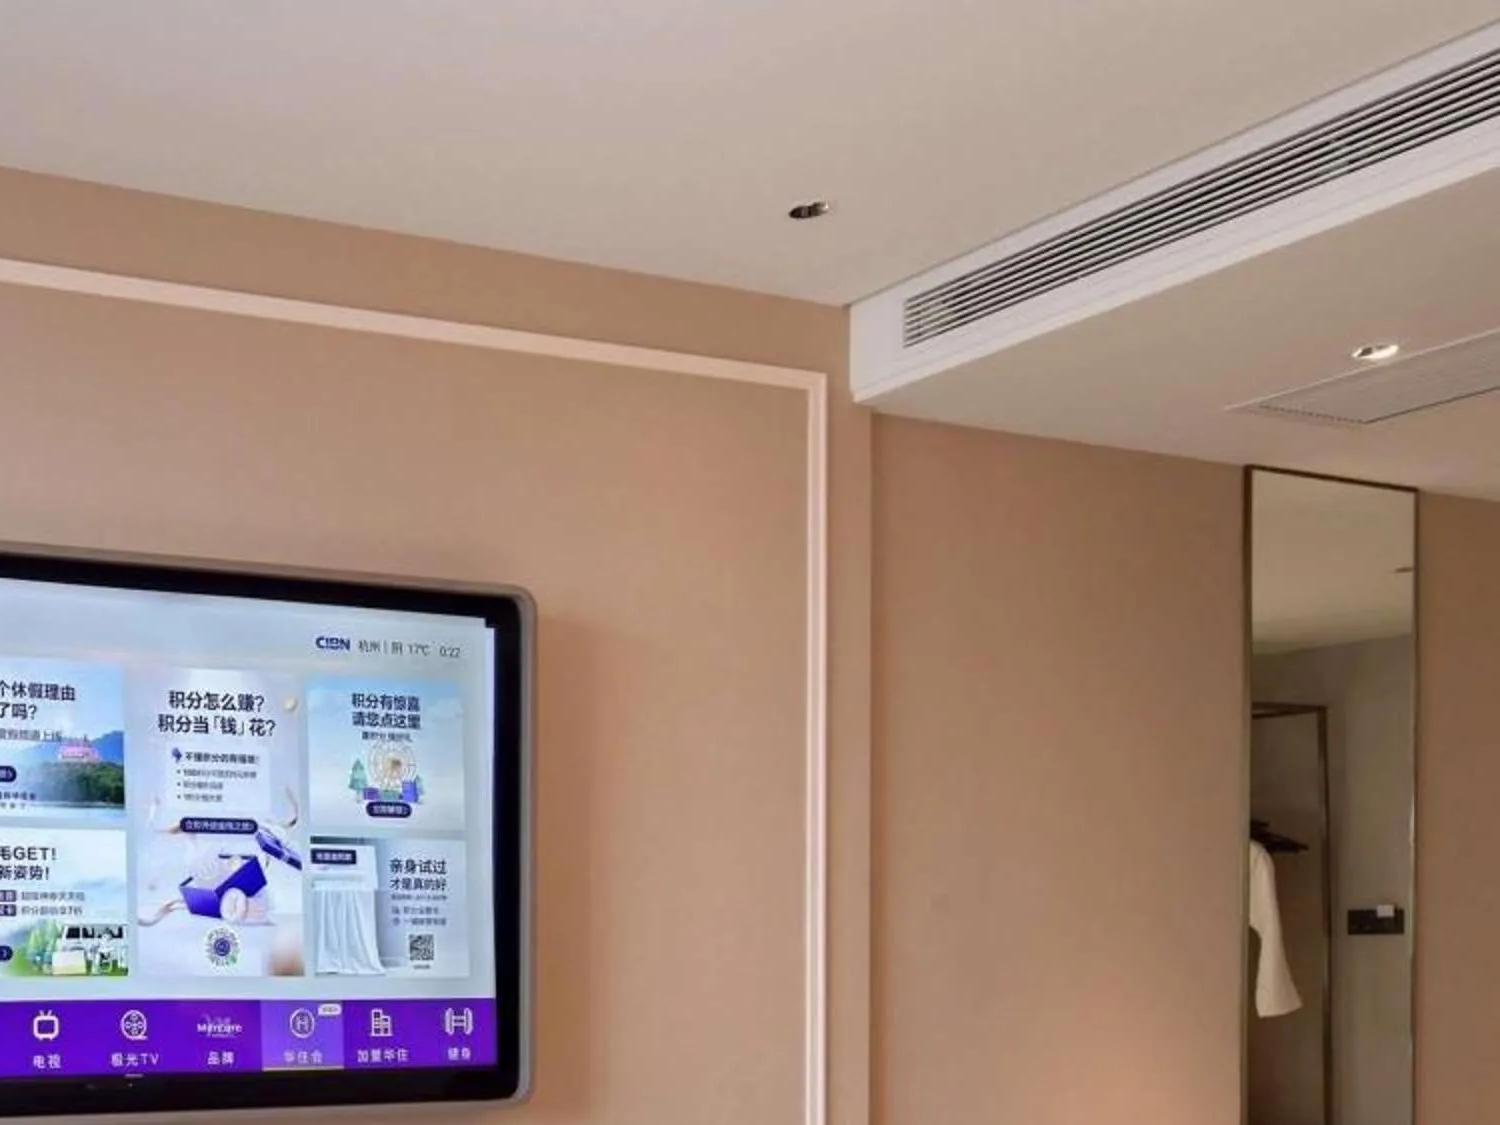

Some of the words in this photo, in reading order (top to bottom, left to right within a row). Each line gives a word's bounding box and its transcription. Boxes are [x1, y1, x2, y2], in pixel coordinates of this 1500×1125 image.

[315, 635, 351, 651] CIBN
[168, 690, 265, 713] 积分怎么赚?
[351, 693, 421, 712] 积分有惊喜
[352, 712, 422, 730] 请您点这里
[389, 858, 448, 875] 亲身试过
[389, 878, 448, 892] 才是真的好
[33, 1053, 62, 1070] 电视
[111, 1051, 160, 1067] 极光TV
[207, 1050, 235, 1066] 品牌
[356, 1047, 410, 1064] 加盟华住
[447, 1045, 472, 1061] 健身
